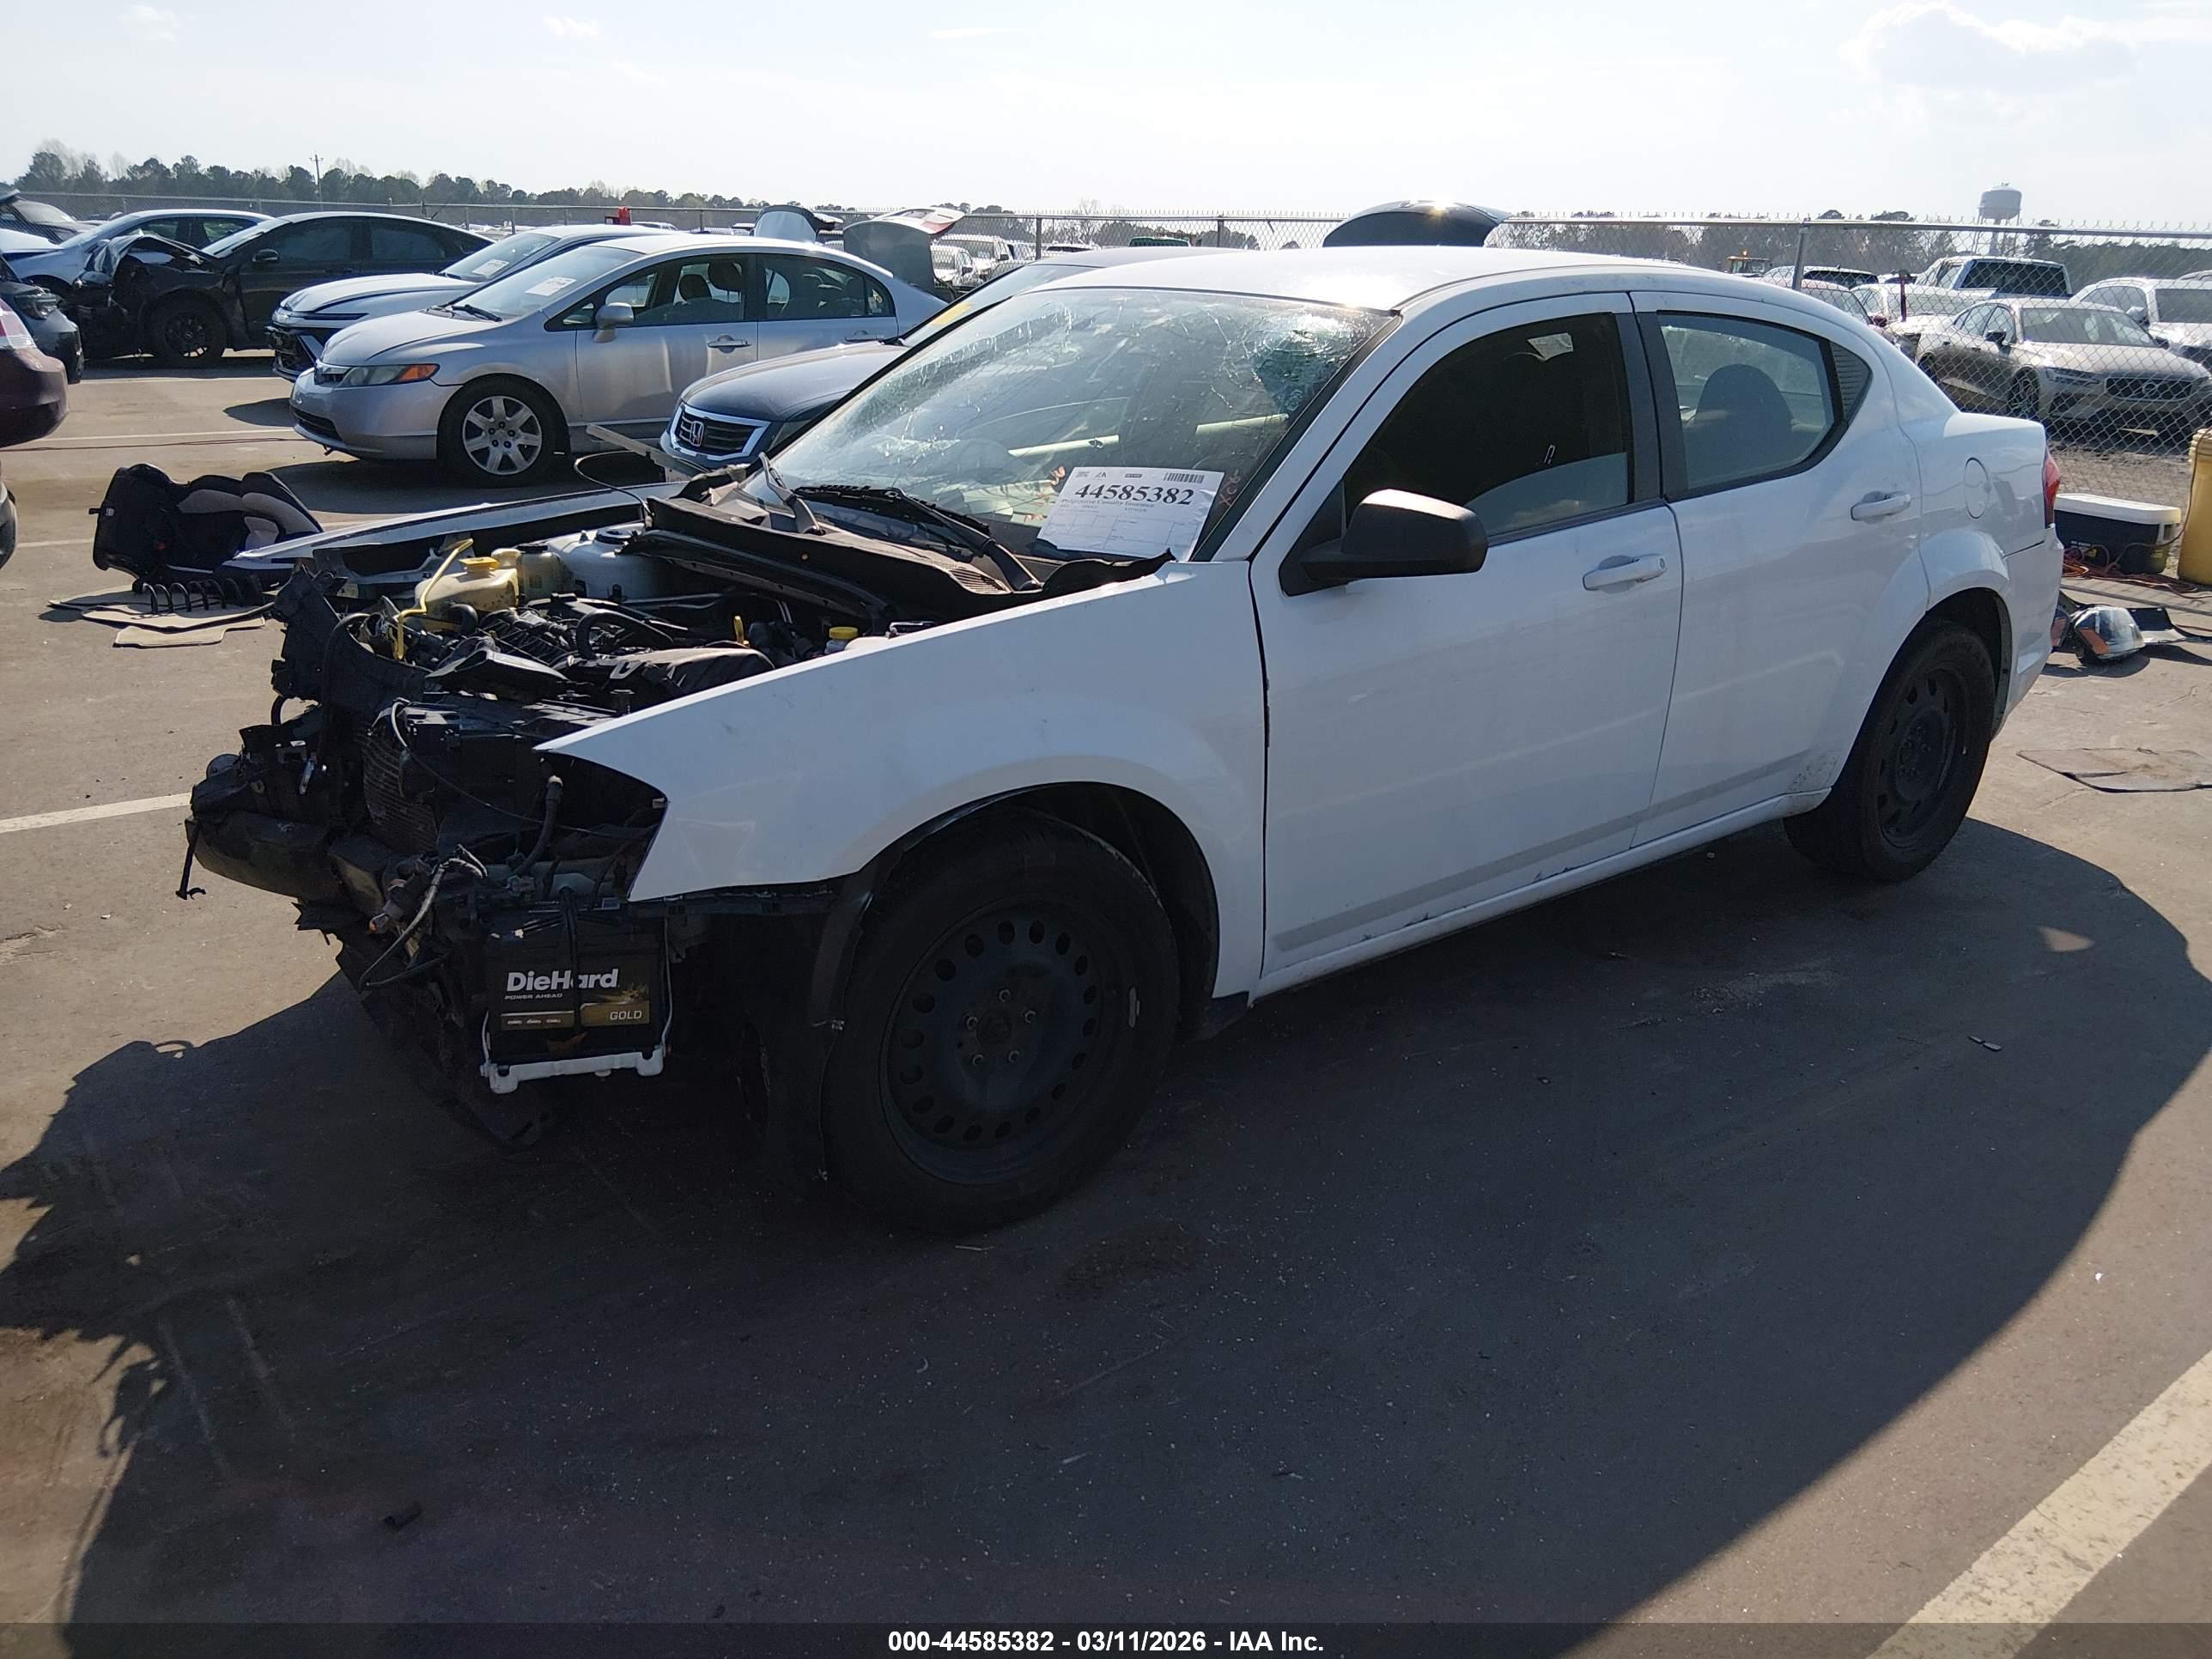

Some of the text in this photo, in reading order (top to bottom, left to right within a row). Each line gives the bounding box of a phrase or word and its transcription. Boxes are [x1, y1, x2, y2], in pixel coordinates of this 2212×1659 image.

[1075, 483, 1194, 506] 44585382
[507, 969, 619, 992] DieHard
[610, 1010, 642, 1020] GOLD
